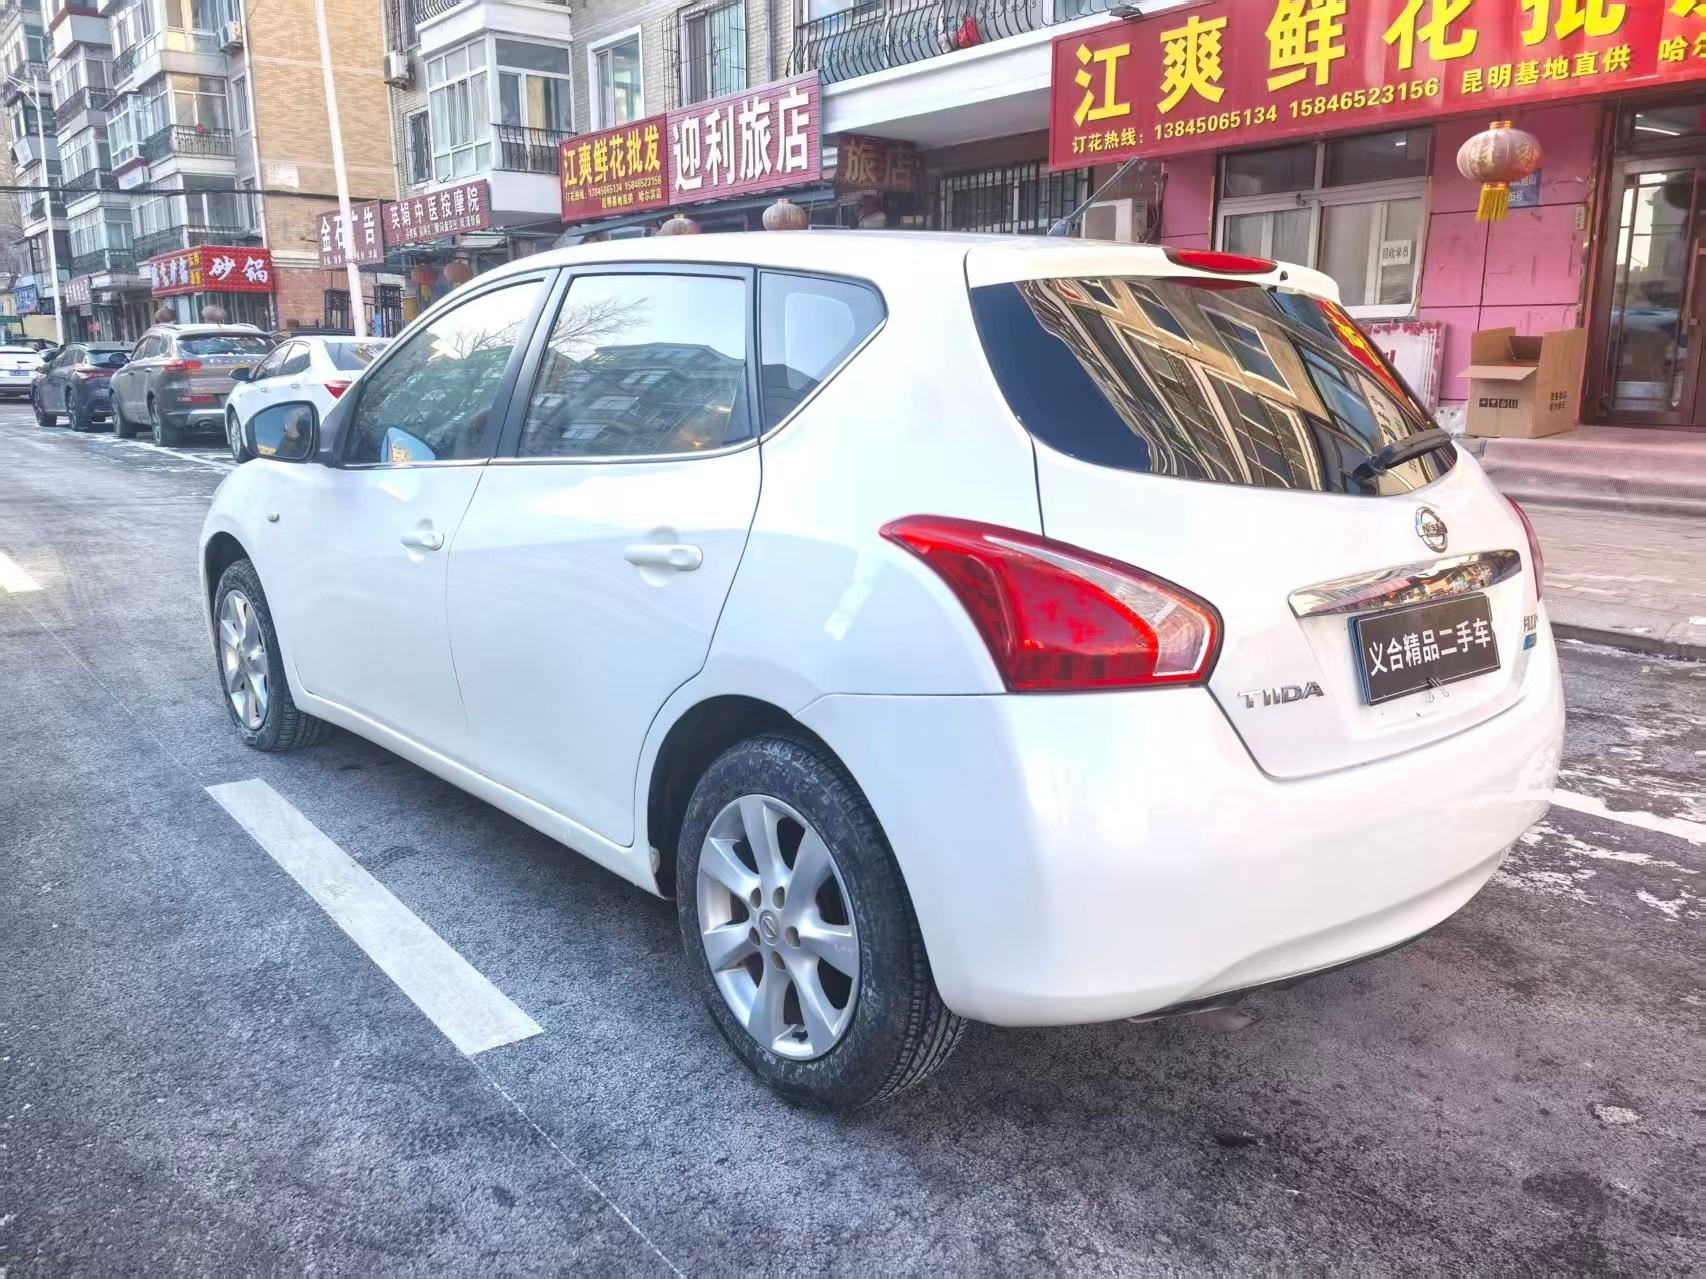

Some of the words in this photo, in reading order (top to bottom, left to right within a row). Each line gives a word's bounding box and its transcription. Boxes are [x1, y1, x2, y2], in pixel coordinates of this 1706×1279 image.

[1154, 104, 1278, 140] 13845065134
[1289, 77, 1440, 119] 15846523156
[1460, 43, 1632, 95] 昆明基地直供
[563, 124, 660, 188] 江爽鲜花批发
[672, 85, 810, 193] 迎利旅店
[1368, 617, 1491, 677] 义合精品二手车
[1238, 681, 1324, 708] TIIDA
